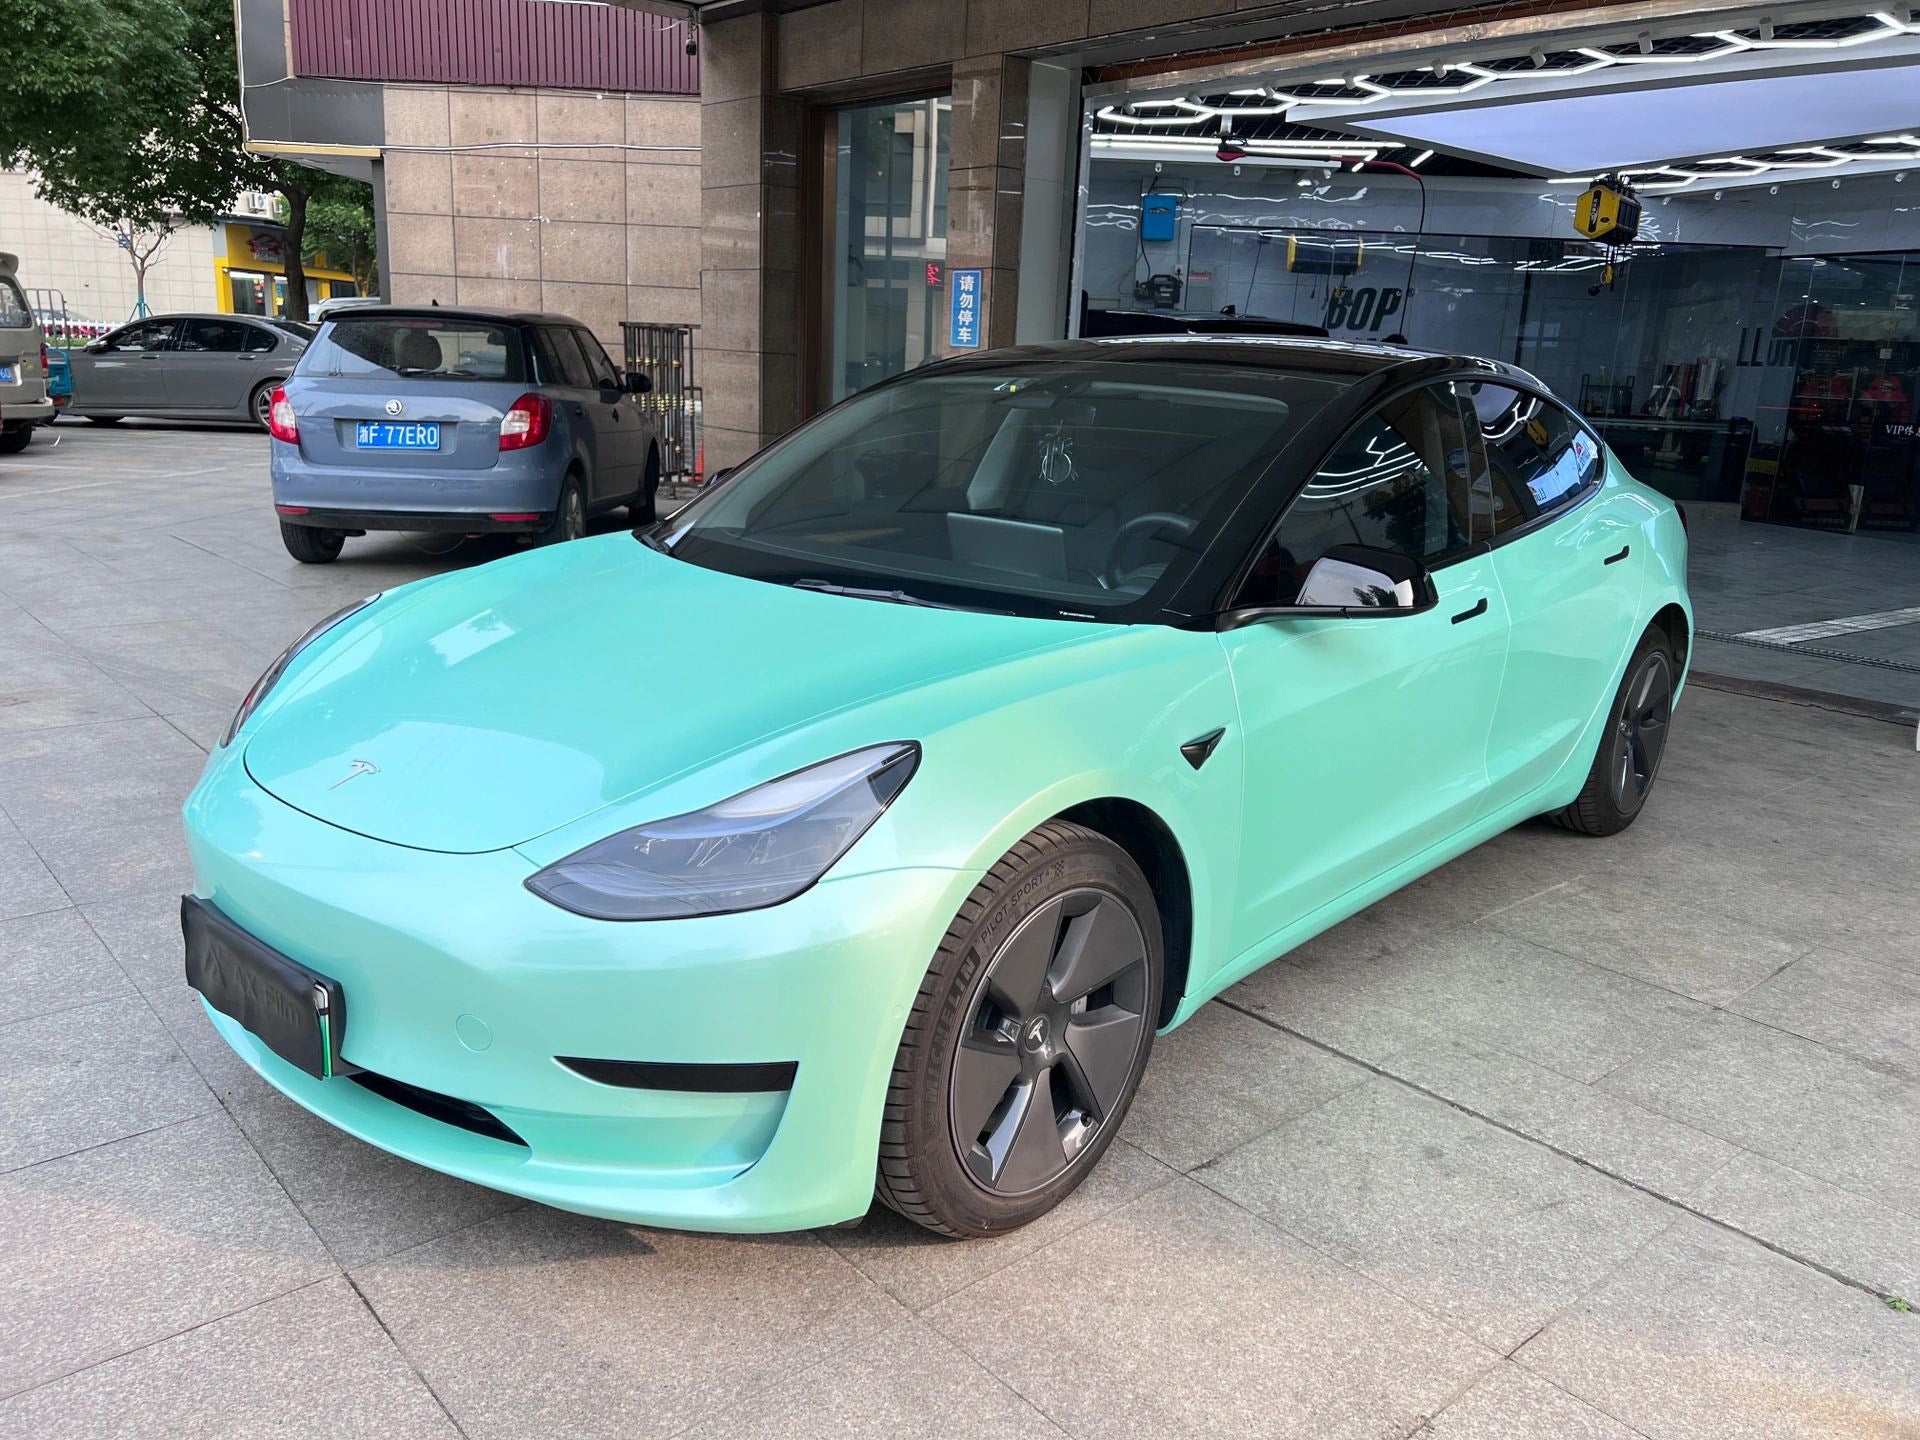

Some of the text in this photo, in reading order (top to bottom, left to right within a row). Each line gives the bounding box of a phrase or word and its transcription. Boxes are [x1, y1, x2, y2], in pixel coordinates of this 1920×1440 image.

[957, 275, 976, 343] 请勿停车
[980, 903, 1010, 944] PILOT
[1009, 872, 1045, 907] SPORT
[925, 953, 977, 1104] MICHELIN
